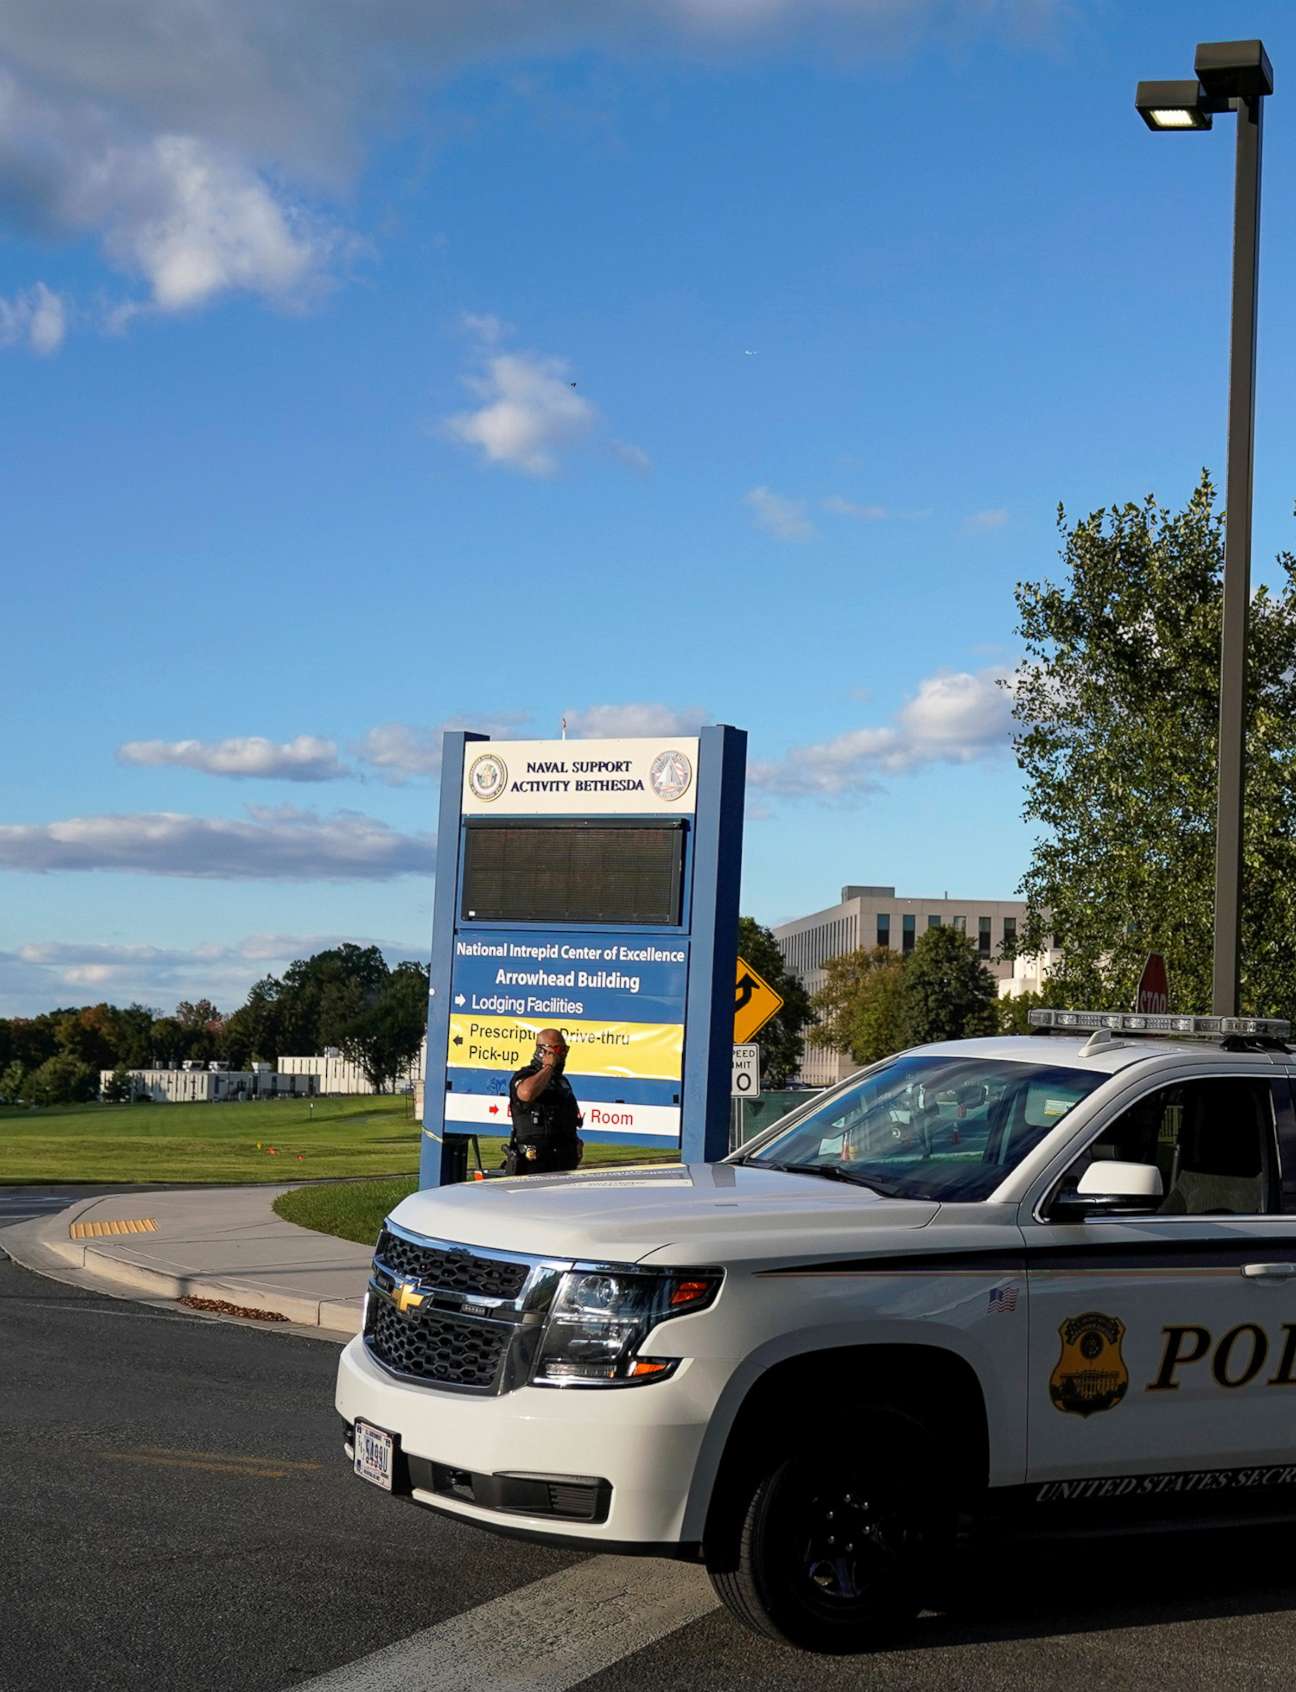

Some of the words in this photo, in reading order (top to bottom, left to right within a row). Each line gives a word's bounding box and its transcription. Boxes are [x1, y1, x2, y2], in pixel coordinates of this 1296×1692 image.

[527, 761, 568, 773] NAVAL
[572, 760, 632, 773] SUPPORT
[510, 780, 570, 792] ACTIVITY
[575, 779, 645, 792] BETHESDA
[457, 942, 507, 957] National
[509, 944, 559, 961] Intrepid
[561, 945, 602, 960] Center
[603, 946, 618, 960] of
[619, 947, 685, 962] Excellence
[495, 969, 575, 987] Arrowhead
[578, 971, 640, 993] Building
[472, 994, 525, 1014] Lodging
[526, 996, 584, 1014] Facilities
[470, 1023, 537, 1041] Prescripti
[559, 1027, 630, 1046] Drive-thru
[469, 1045, 519, 1064] Pick-up
[736, 1072, 752, 1092] 0
[591, 1109, 633, 1126] Room
[1036, 1477, 1137, 1502] UNITED
[1137, 1471, 1232, 1494] STATES
